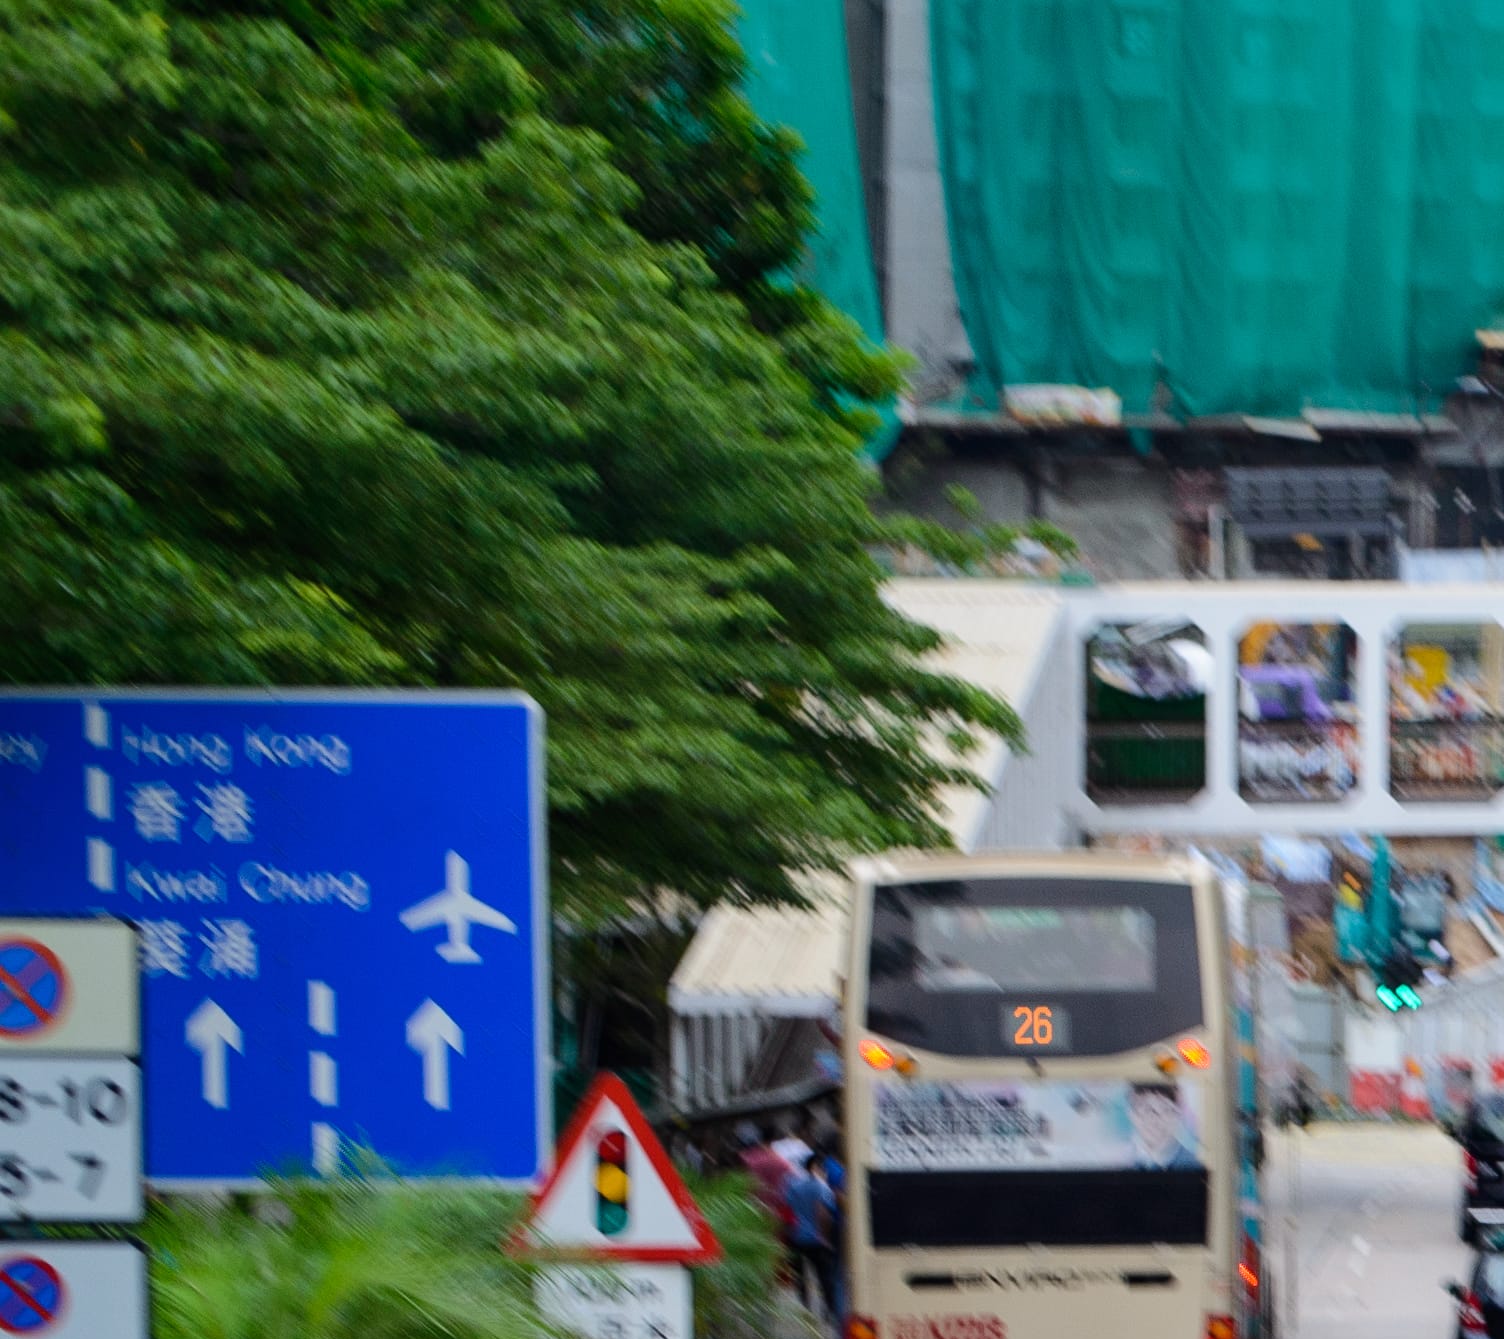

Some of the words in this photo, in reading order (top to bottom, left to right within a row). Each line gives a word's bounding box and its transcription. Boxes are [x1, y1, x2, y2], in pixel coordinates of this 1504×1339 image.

[122, 722, 232, 774] Hong
[243, 722, 352, 776] Kong
[125, 780, 255, 844] 香港
[125, 861, 228, 903] Kwai
[237, 861, 371, 912] Chung
[1013, 1005, 1053, 1046] 26
